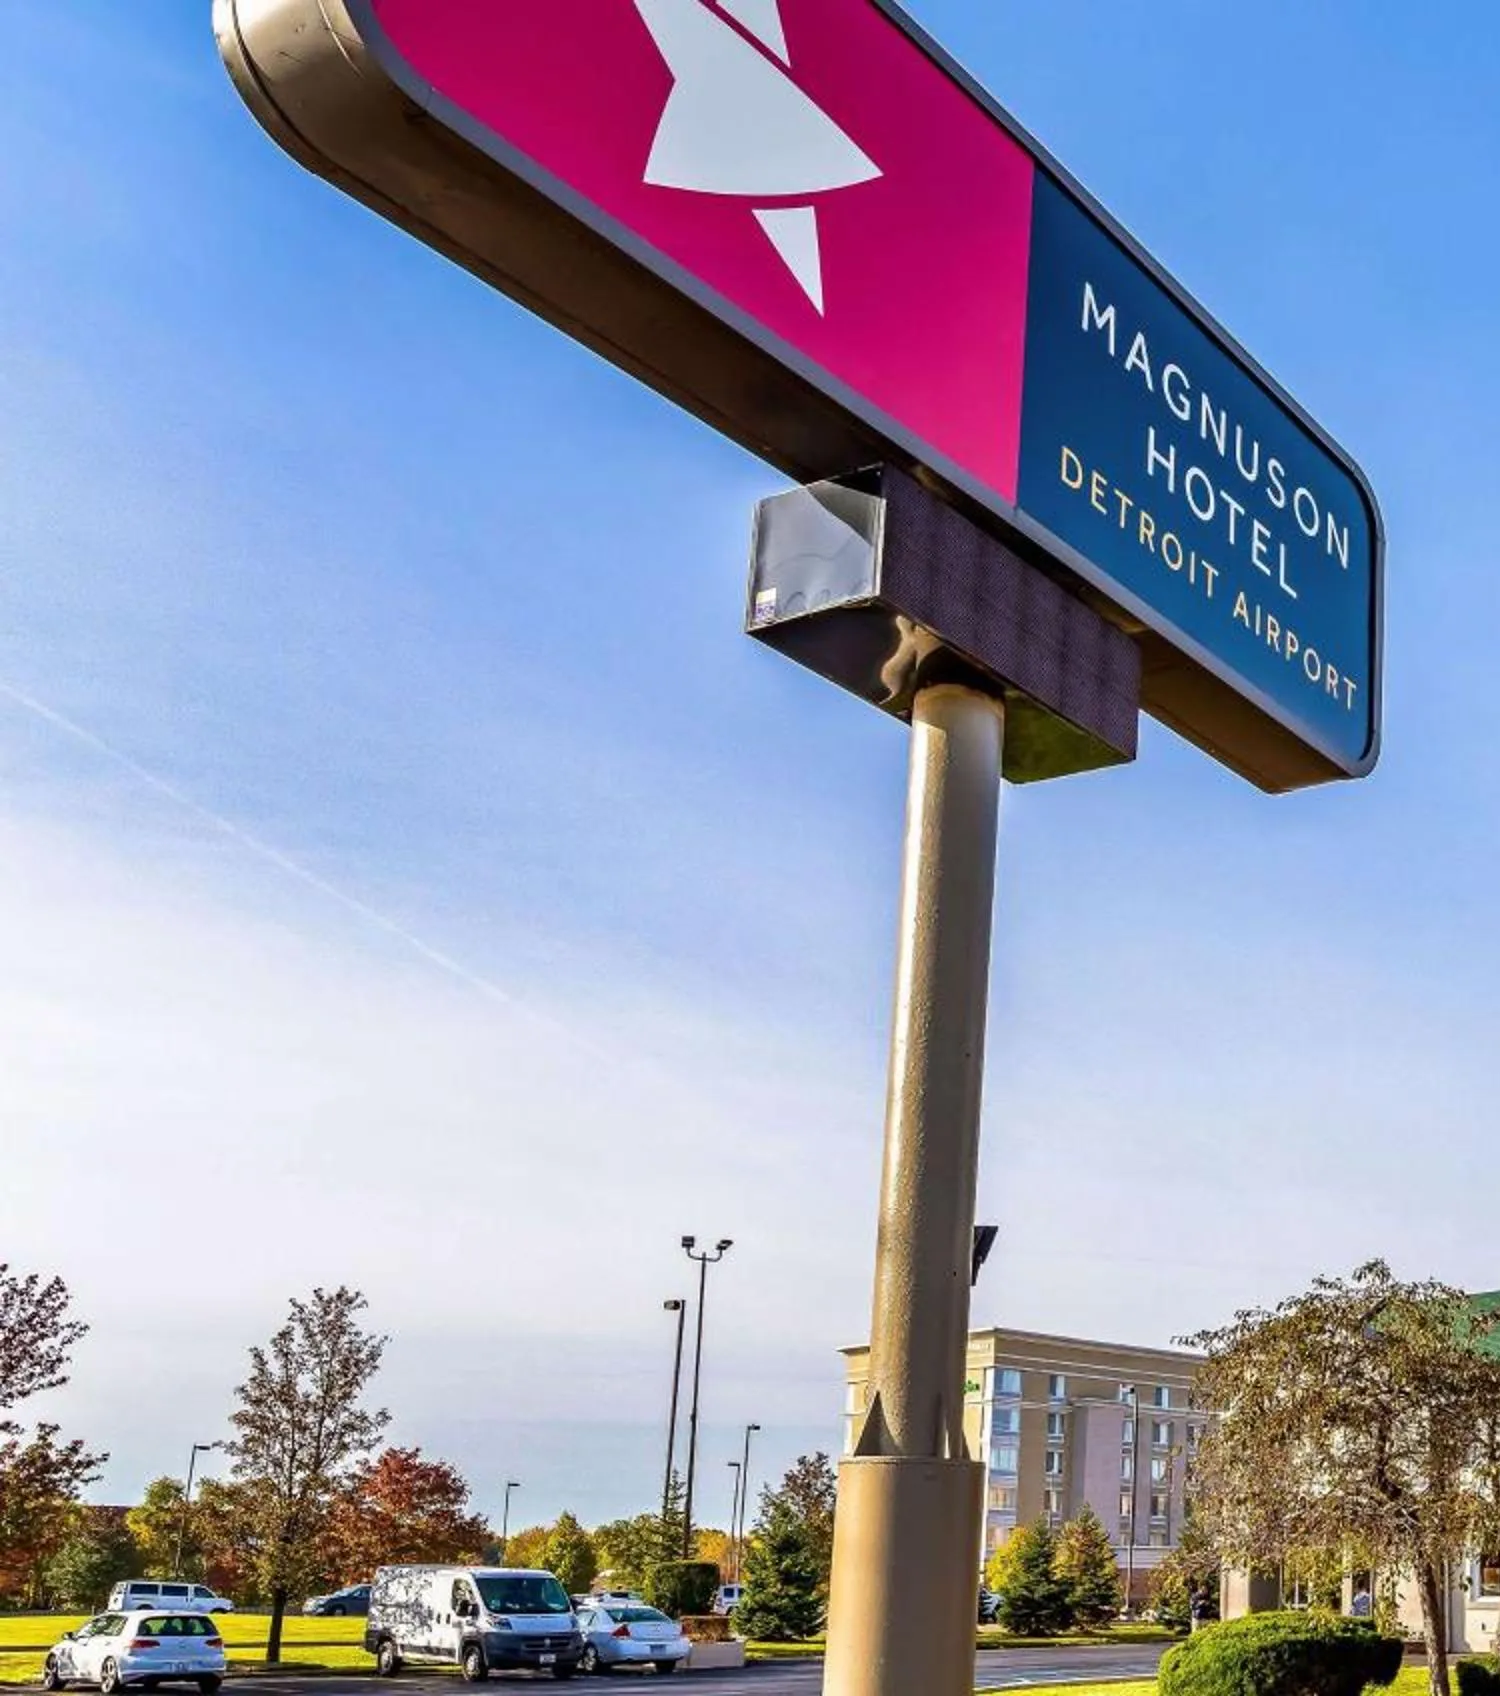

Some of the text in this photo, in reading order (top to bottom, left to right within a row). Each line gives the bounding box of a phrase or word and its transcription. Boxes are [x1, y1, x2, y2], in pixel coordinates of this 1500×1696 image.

[1081, 281, 1349, 570] MAGNUSON
[1146, 426, 1298, 600] HOTEL
[1060, 446, 1358, 711] DETROIT AIRPORT
